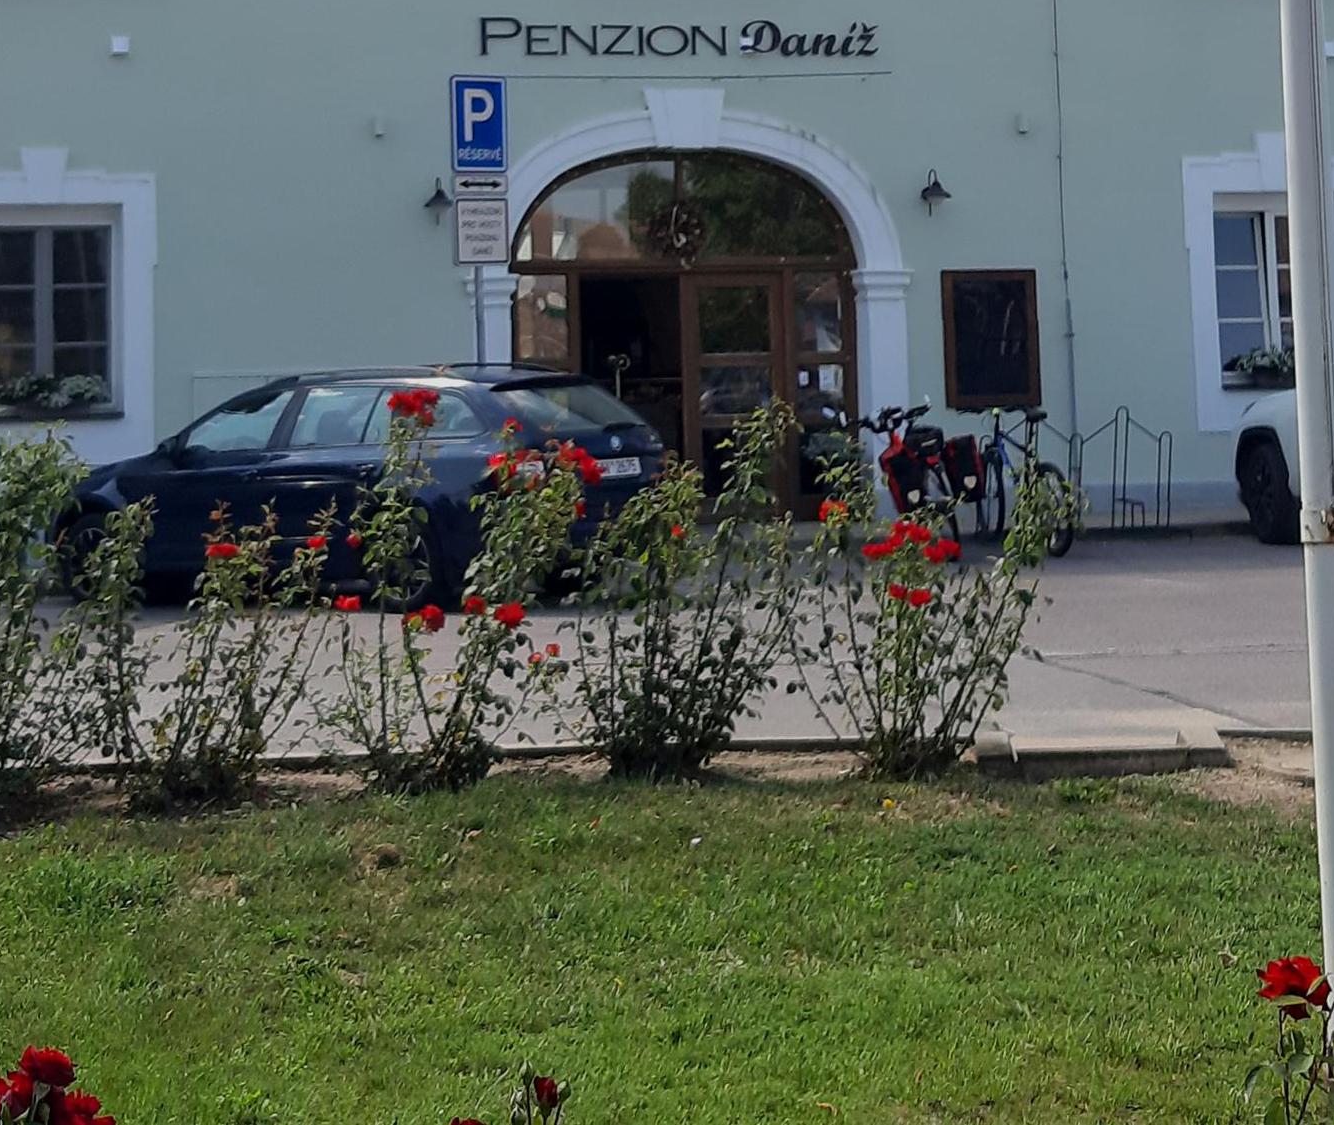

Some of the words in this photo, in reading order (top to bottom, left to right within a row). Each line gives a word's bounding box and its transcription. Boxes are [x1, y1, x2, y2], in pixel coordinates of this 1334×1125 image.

[479, 16, 728, 57] PENZION
[739, 19, 880, 58] Daníž
[463, 88, 495, 142] P
